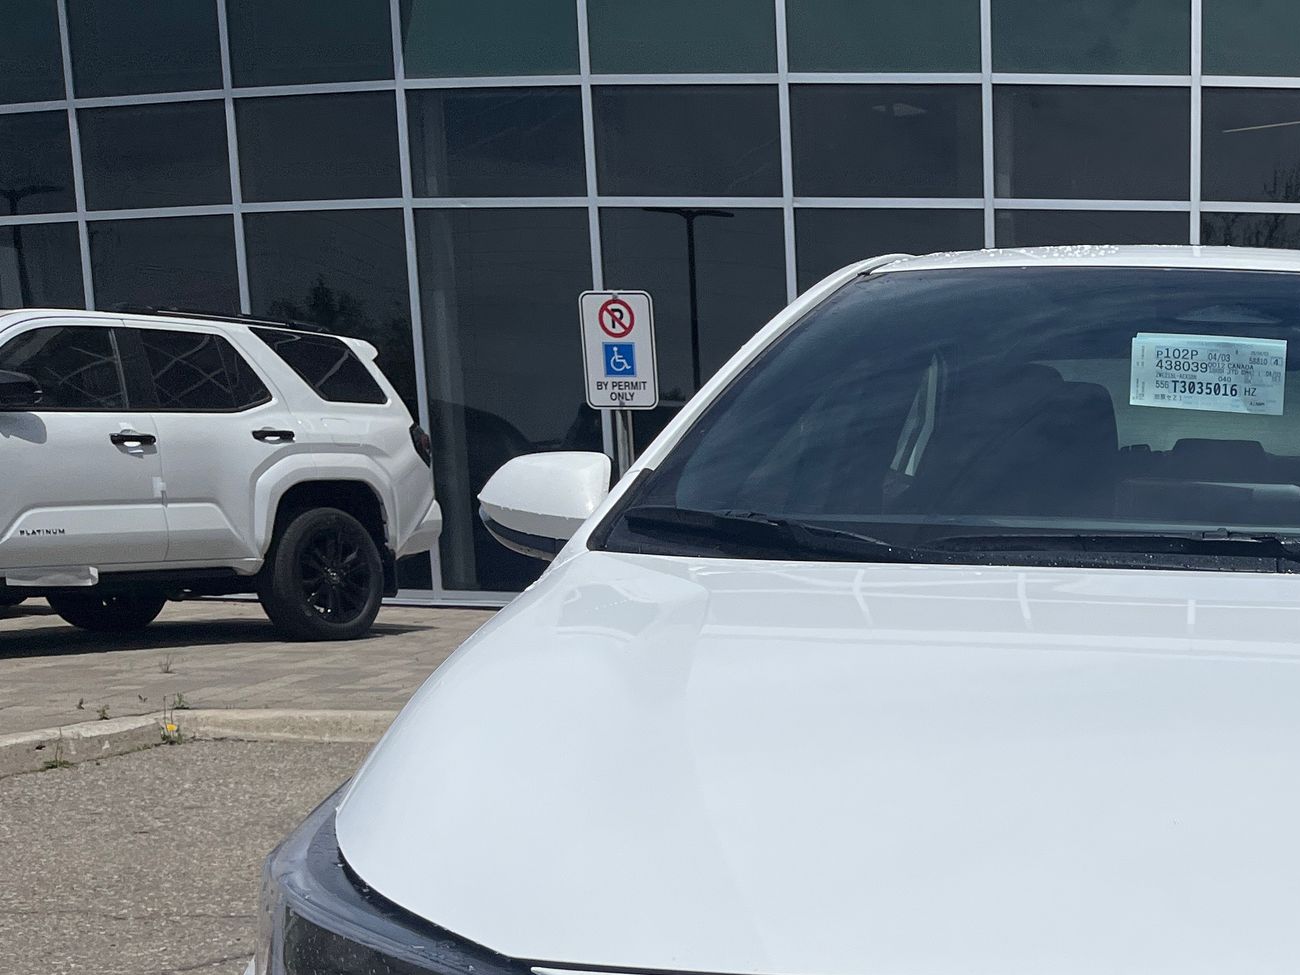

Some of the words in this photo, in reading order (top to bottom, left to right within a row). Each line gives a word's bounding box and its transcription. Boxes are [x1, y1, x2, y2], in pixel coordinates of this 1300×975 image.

[1156, 348, 1199, 360] P102P
[1207, 352, 1231, 363] 04/03
[1155, 359, 1208, 373] 438039
[597, 381, 608, 391] BY
[612, 381, 647, 391] PERMIT
[1172, 380, 1238, 397] T3035016
[1244, 387, 1257, 397] HZ
[610, 392, 635, 402] ONLY
[19, 528, 66, 536] PLATINUM
